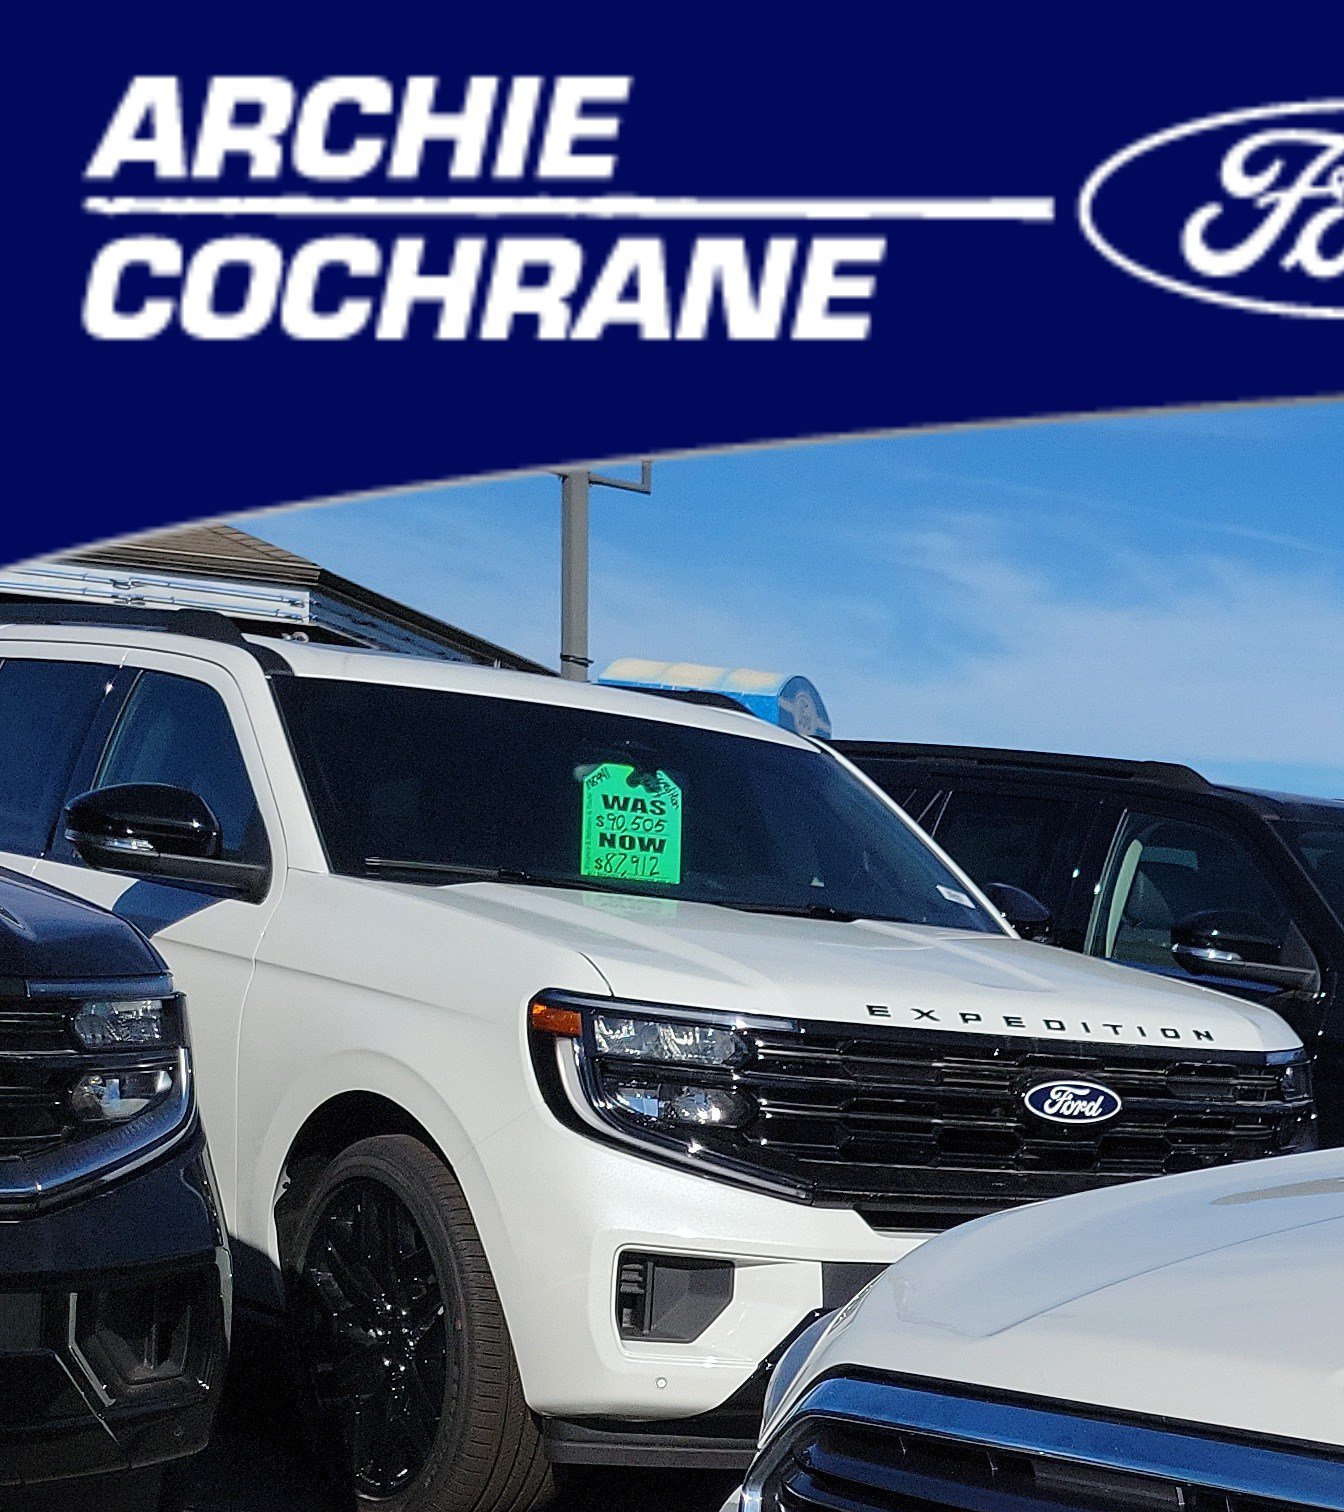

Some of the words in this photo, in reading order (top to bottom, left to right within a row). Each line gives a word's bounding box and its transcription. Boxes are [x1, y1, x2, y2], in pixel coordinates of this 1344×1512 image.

[601, 793, 667, 816] WAS
[595, 812, 668, 833] $90,505
[598, 832, 667, 855] NOW
[594, 852, 661, 877] $87,912
[866, 1004, 1215, 1042] EXPEDITION
[1043, 1085, 1103, 1118] Ford
